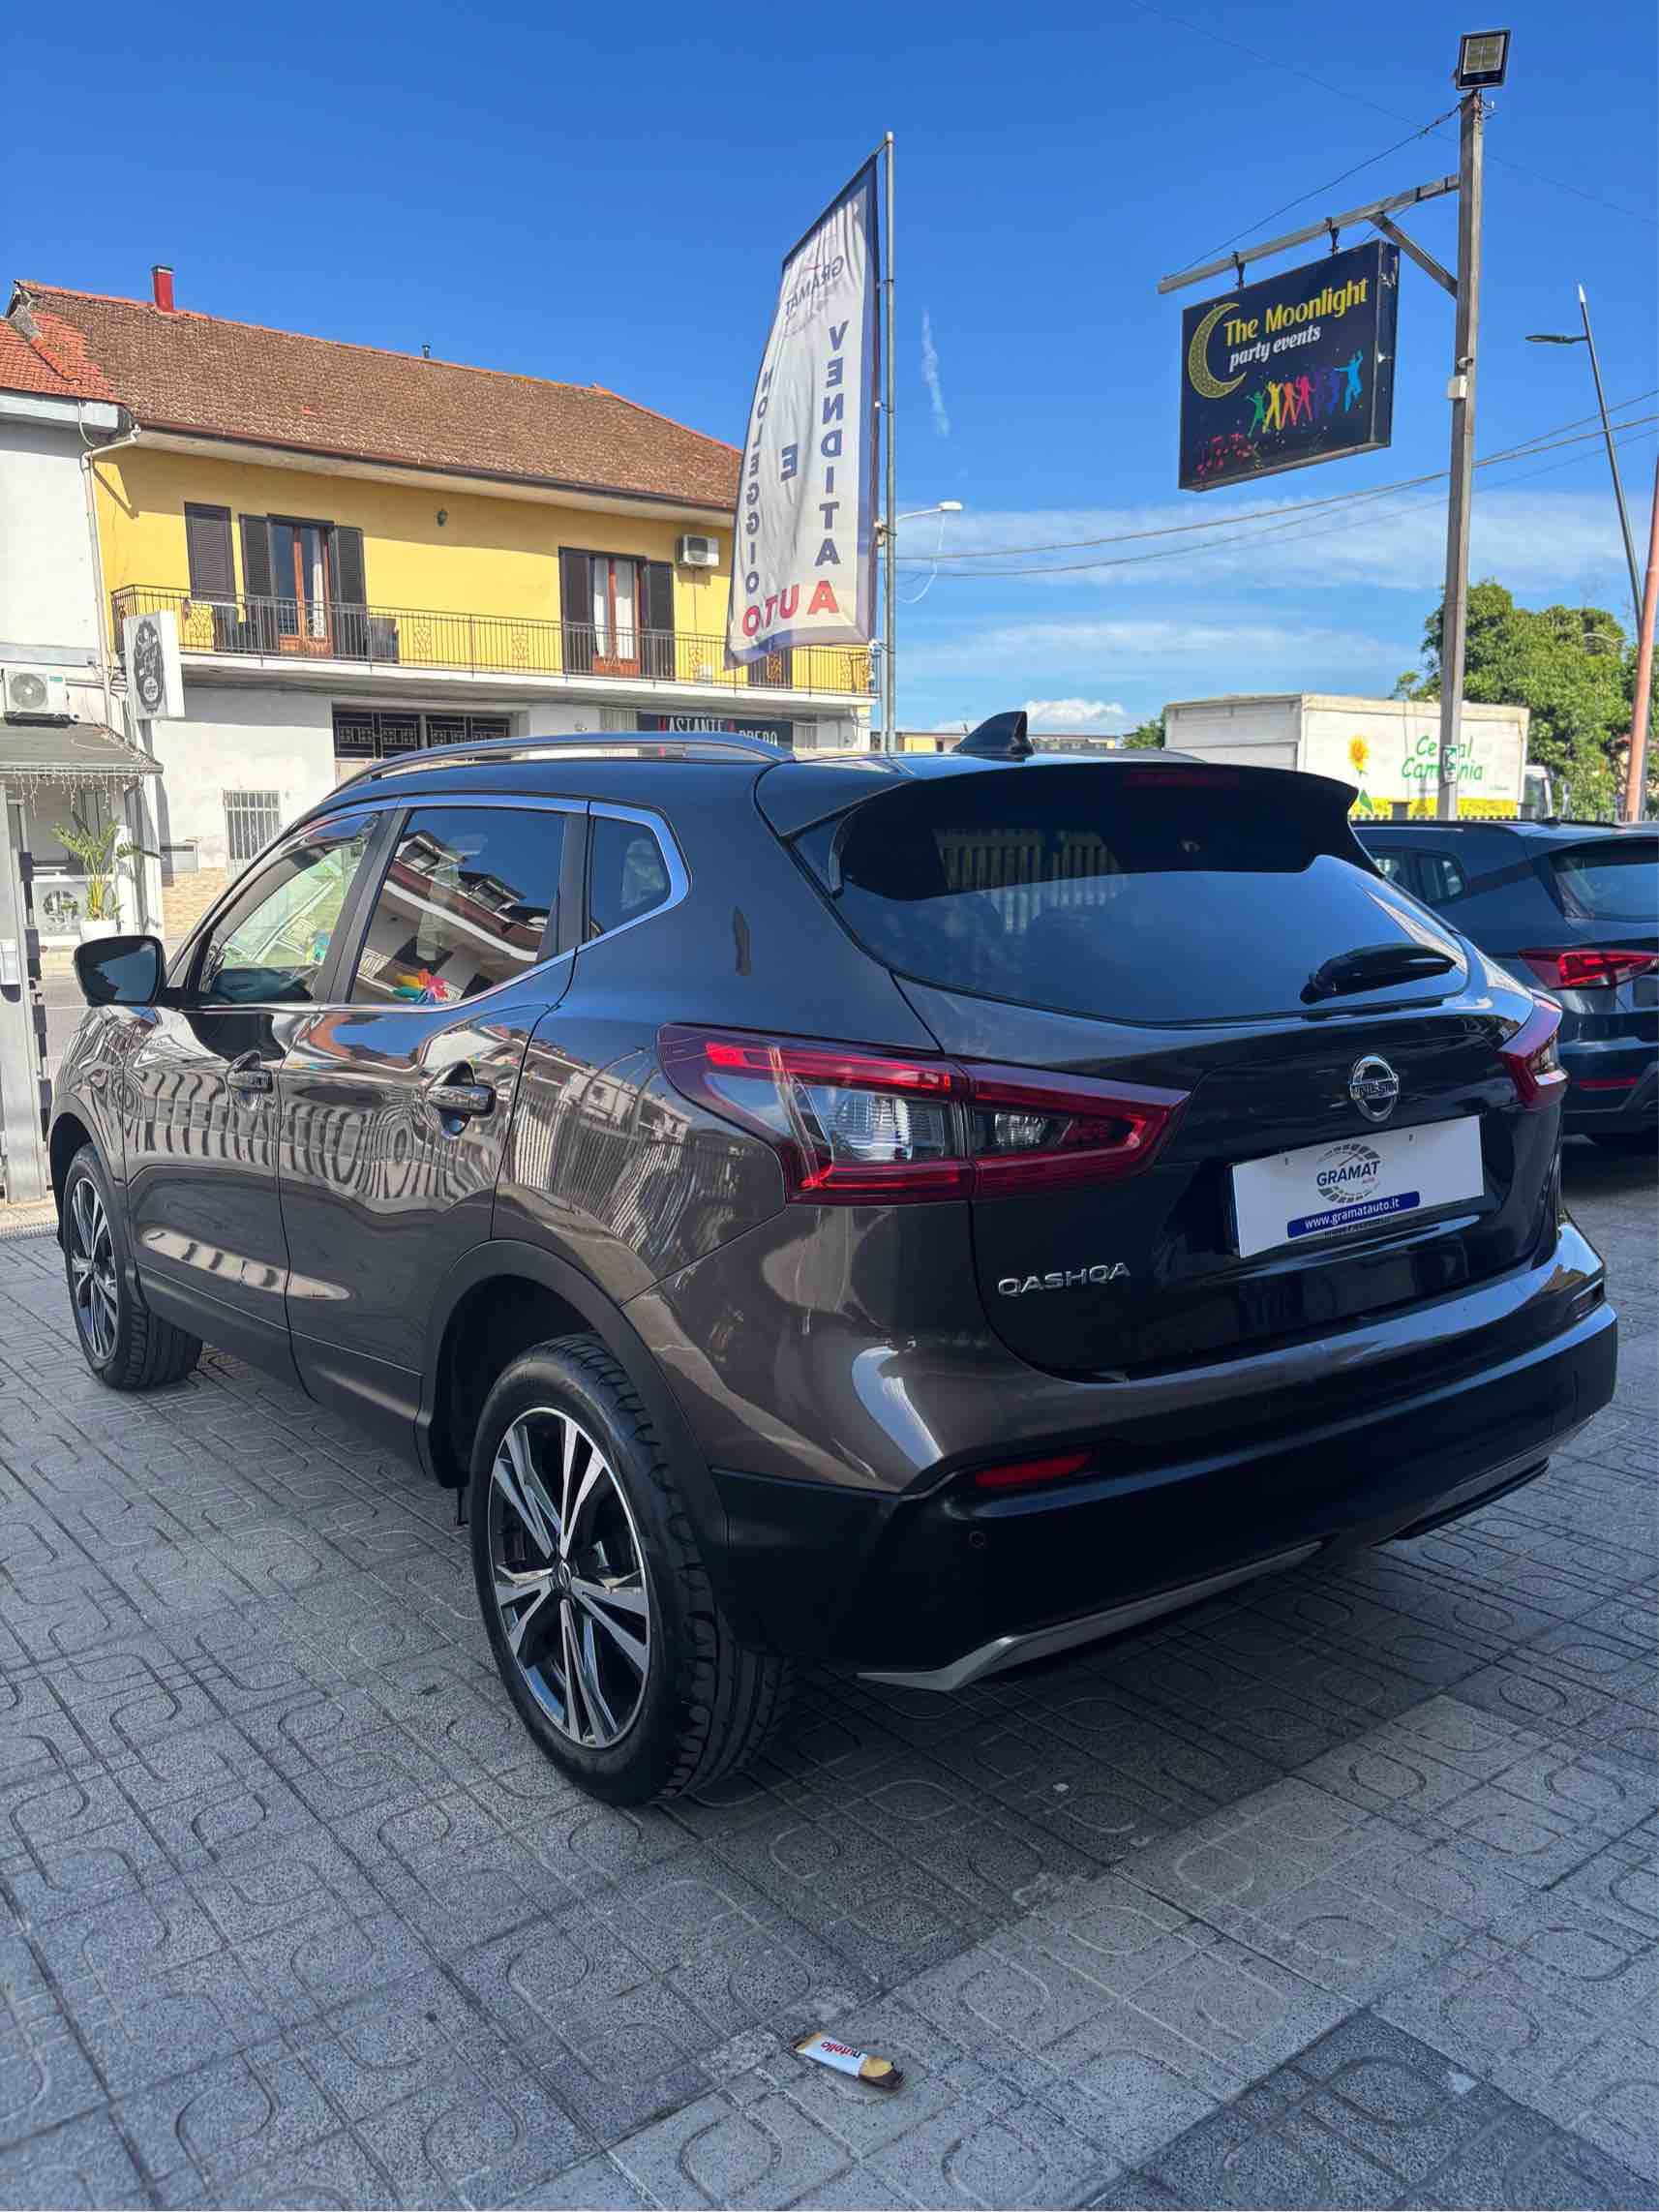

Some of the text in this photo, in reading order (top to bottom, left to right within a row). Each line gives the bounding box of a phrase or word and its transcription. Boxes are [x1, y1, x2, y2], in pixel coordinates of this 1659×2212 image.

[1223, 278, 1369, 347] The Moonlight
[1229, 325, 1321, 373] party events
[1402, 757, 1483, 780] Camnia
[1316, 1161, 1380, 1187] GRAMAT
[1304, 1197, 1401, 1230] www.gramatauto.it
